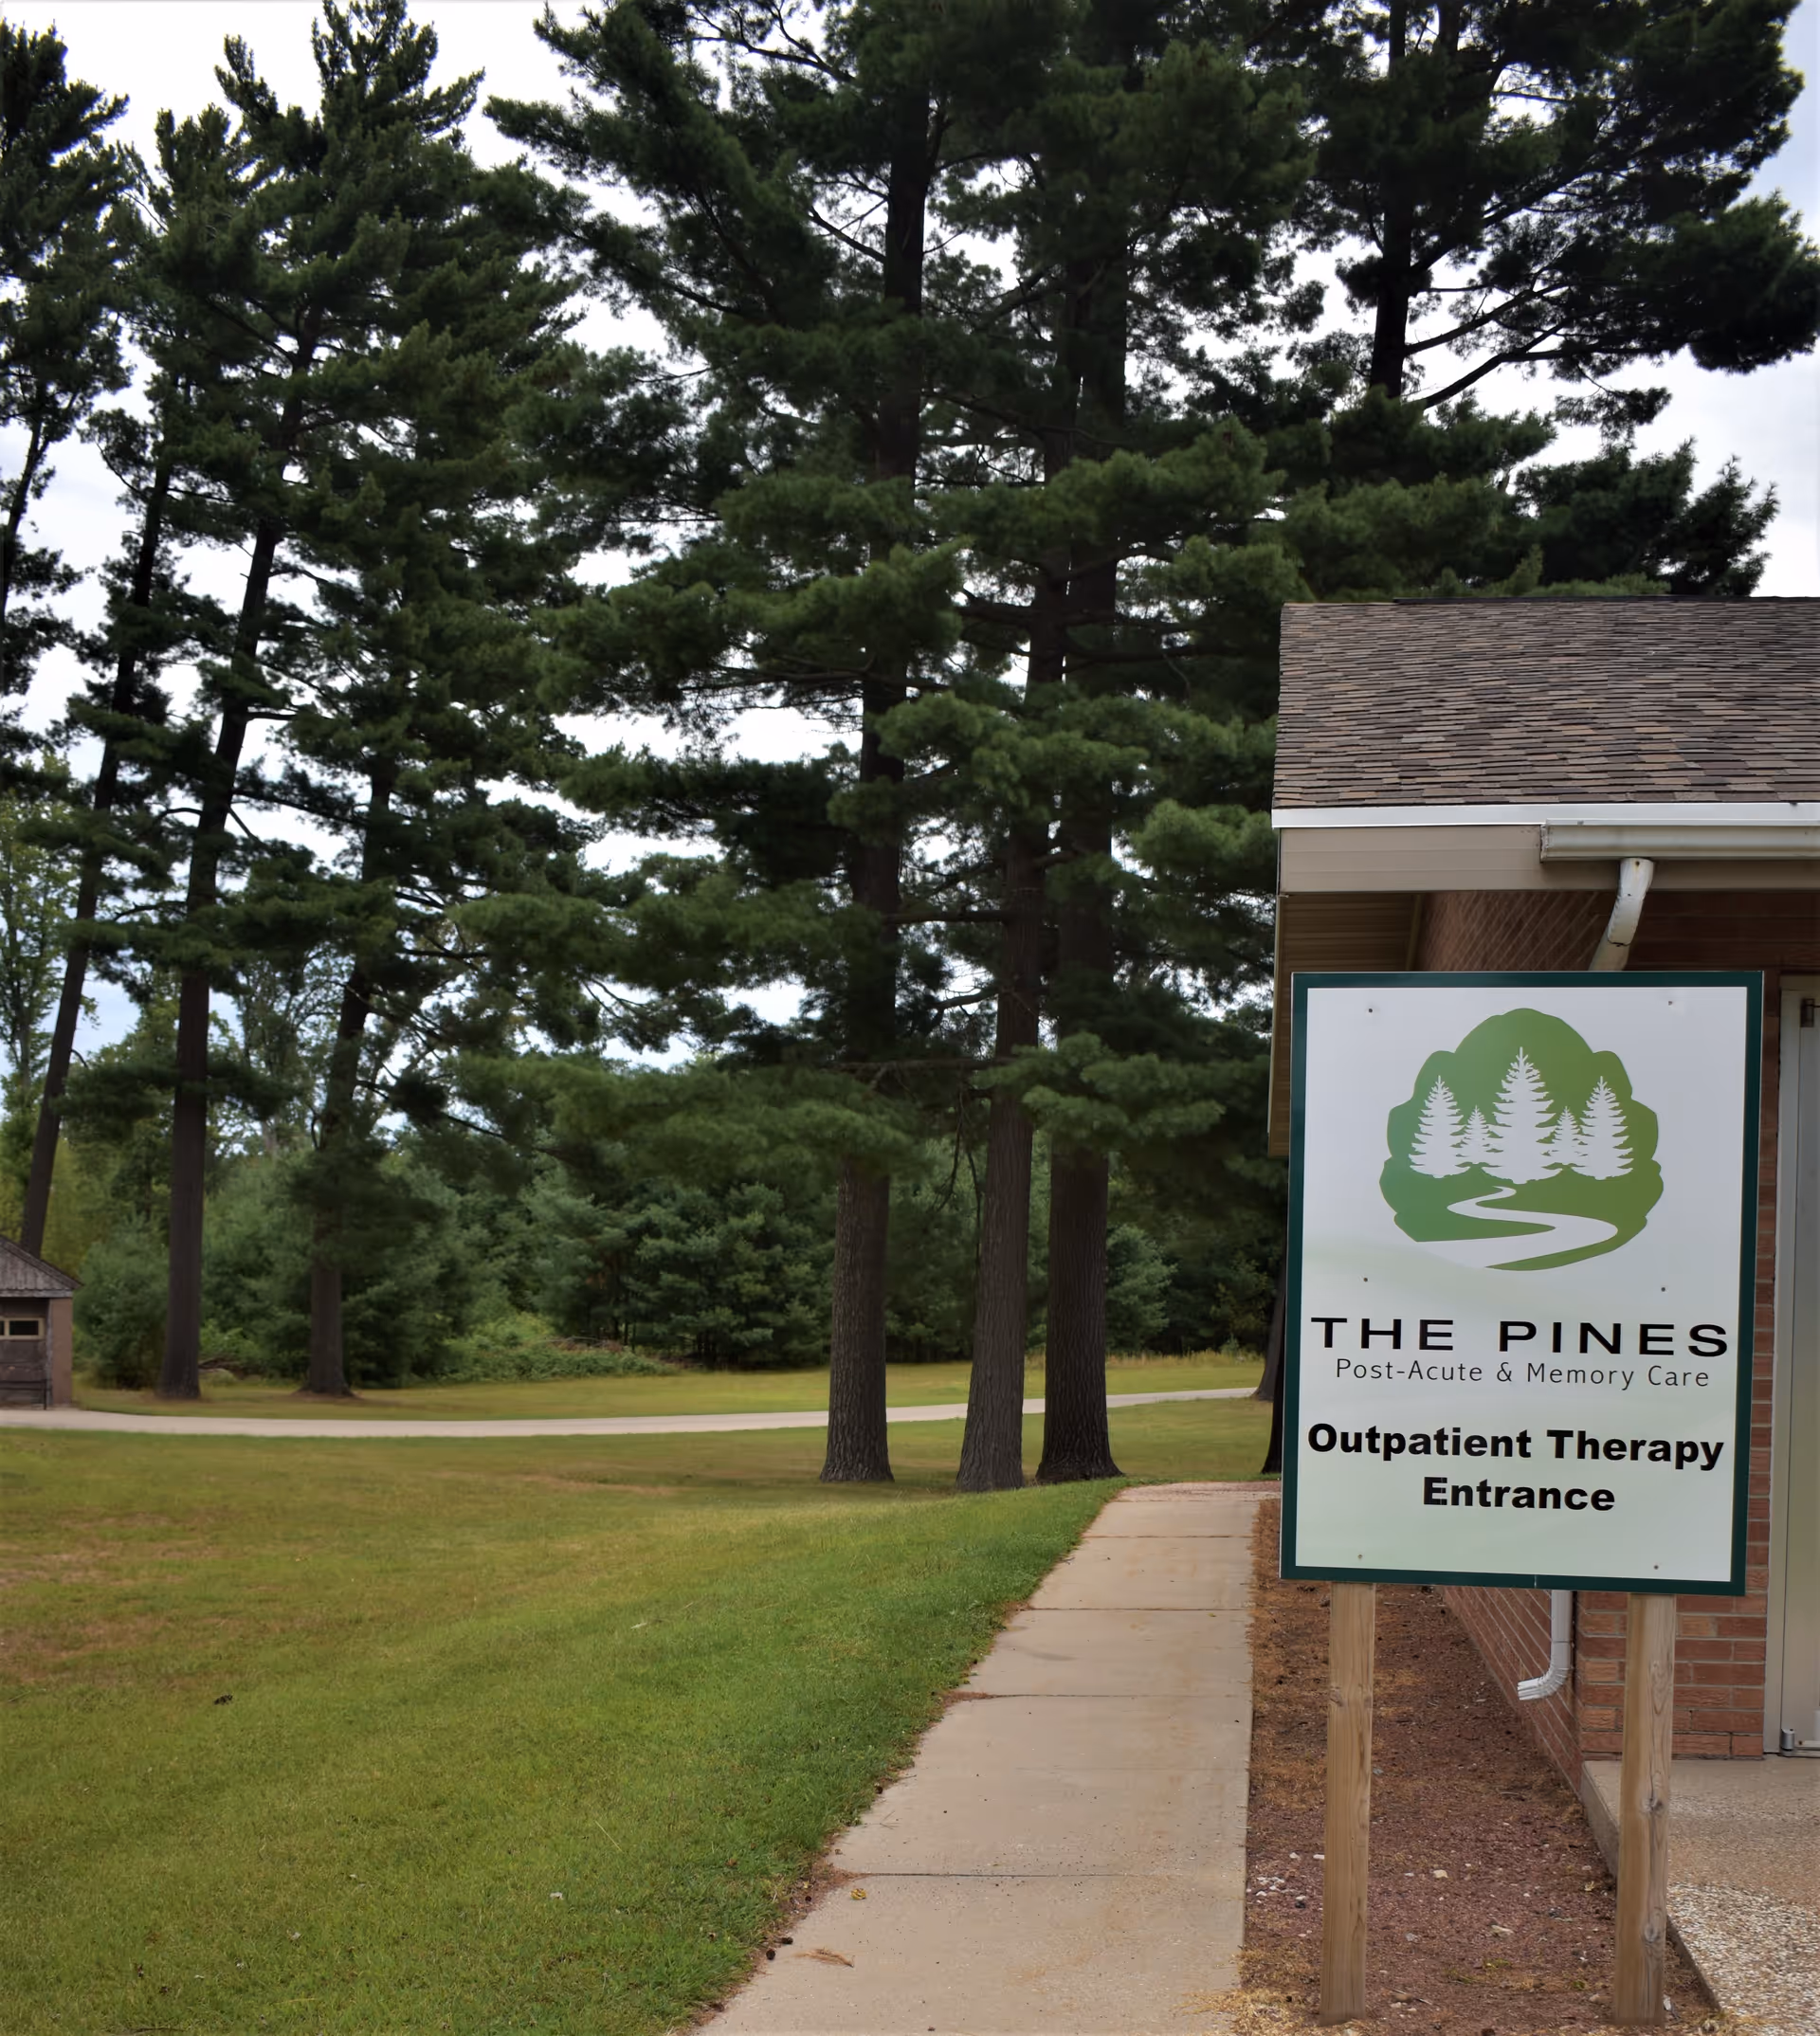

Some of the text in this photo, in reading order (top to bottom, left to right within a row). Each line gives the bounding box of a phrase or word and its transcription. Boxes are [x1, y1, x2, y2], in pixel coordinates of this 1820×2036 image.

[1311, 1317, 1728, 1358] THE PINES
[1336, 1357, 1710, 1391] Post-Acute & Memory Care
[1307, 1423, 1725, 1472] Outpatient Therapy
[1423, 1476, 1616, 1512] Entrance
